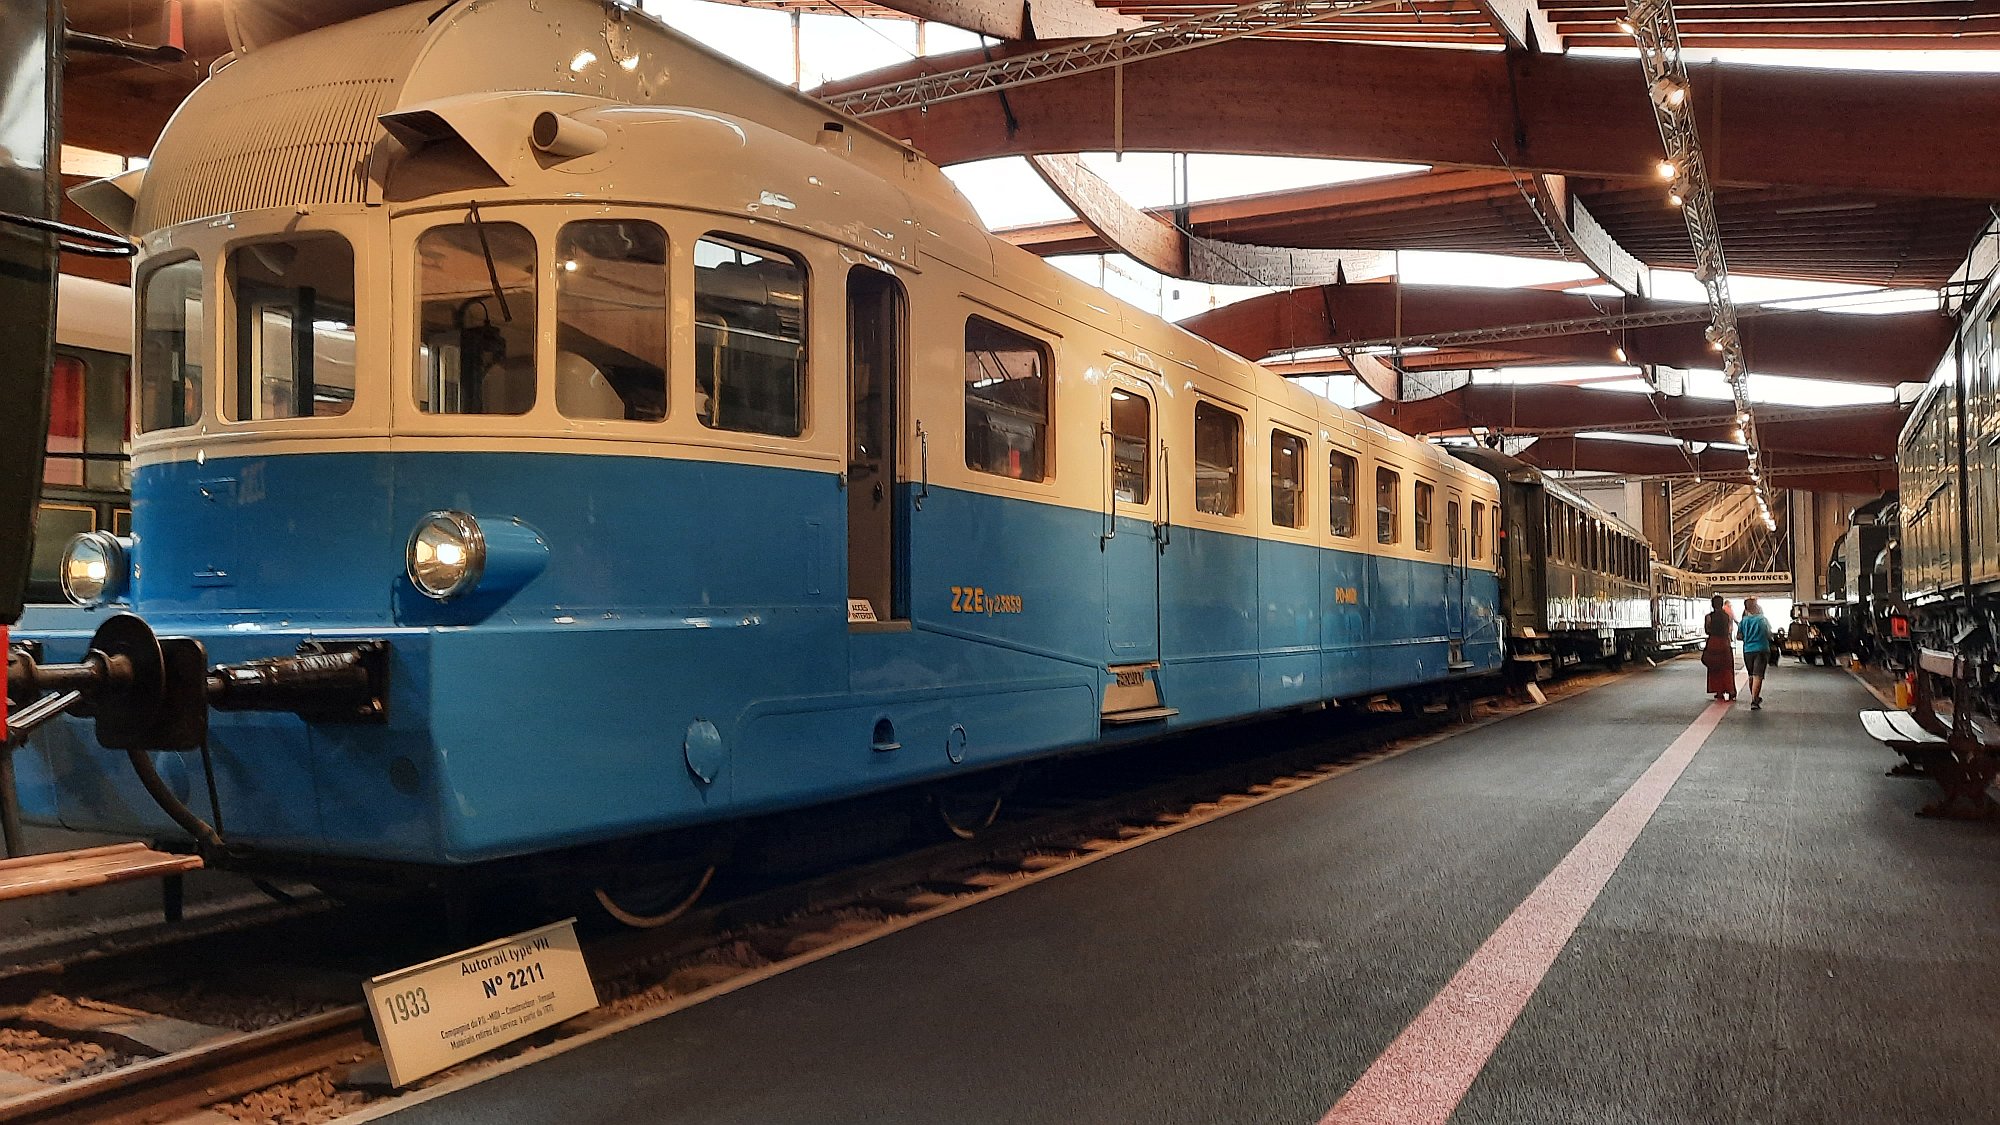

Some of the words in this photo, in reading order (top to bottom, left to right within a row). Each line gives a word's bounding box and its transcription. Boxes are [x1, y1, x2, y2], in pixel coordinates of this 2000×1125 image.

[951, 586, 984, 612] ZZE
[461, 949, 508, 976] Autorail
[508, 943, 532, 961] type
[507, 962, 545, 991] 2211
[385, 986, 430, 1025] 1933
[499, 1019, 518, 1031] service
